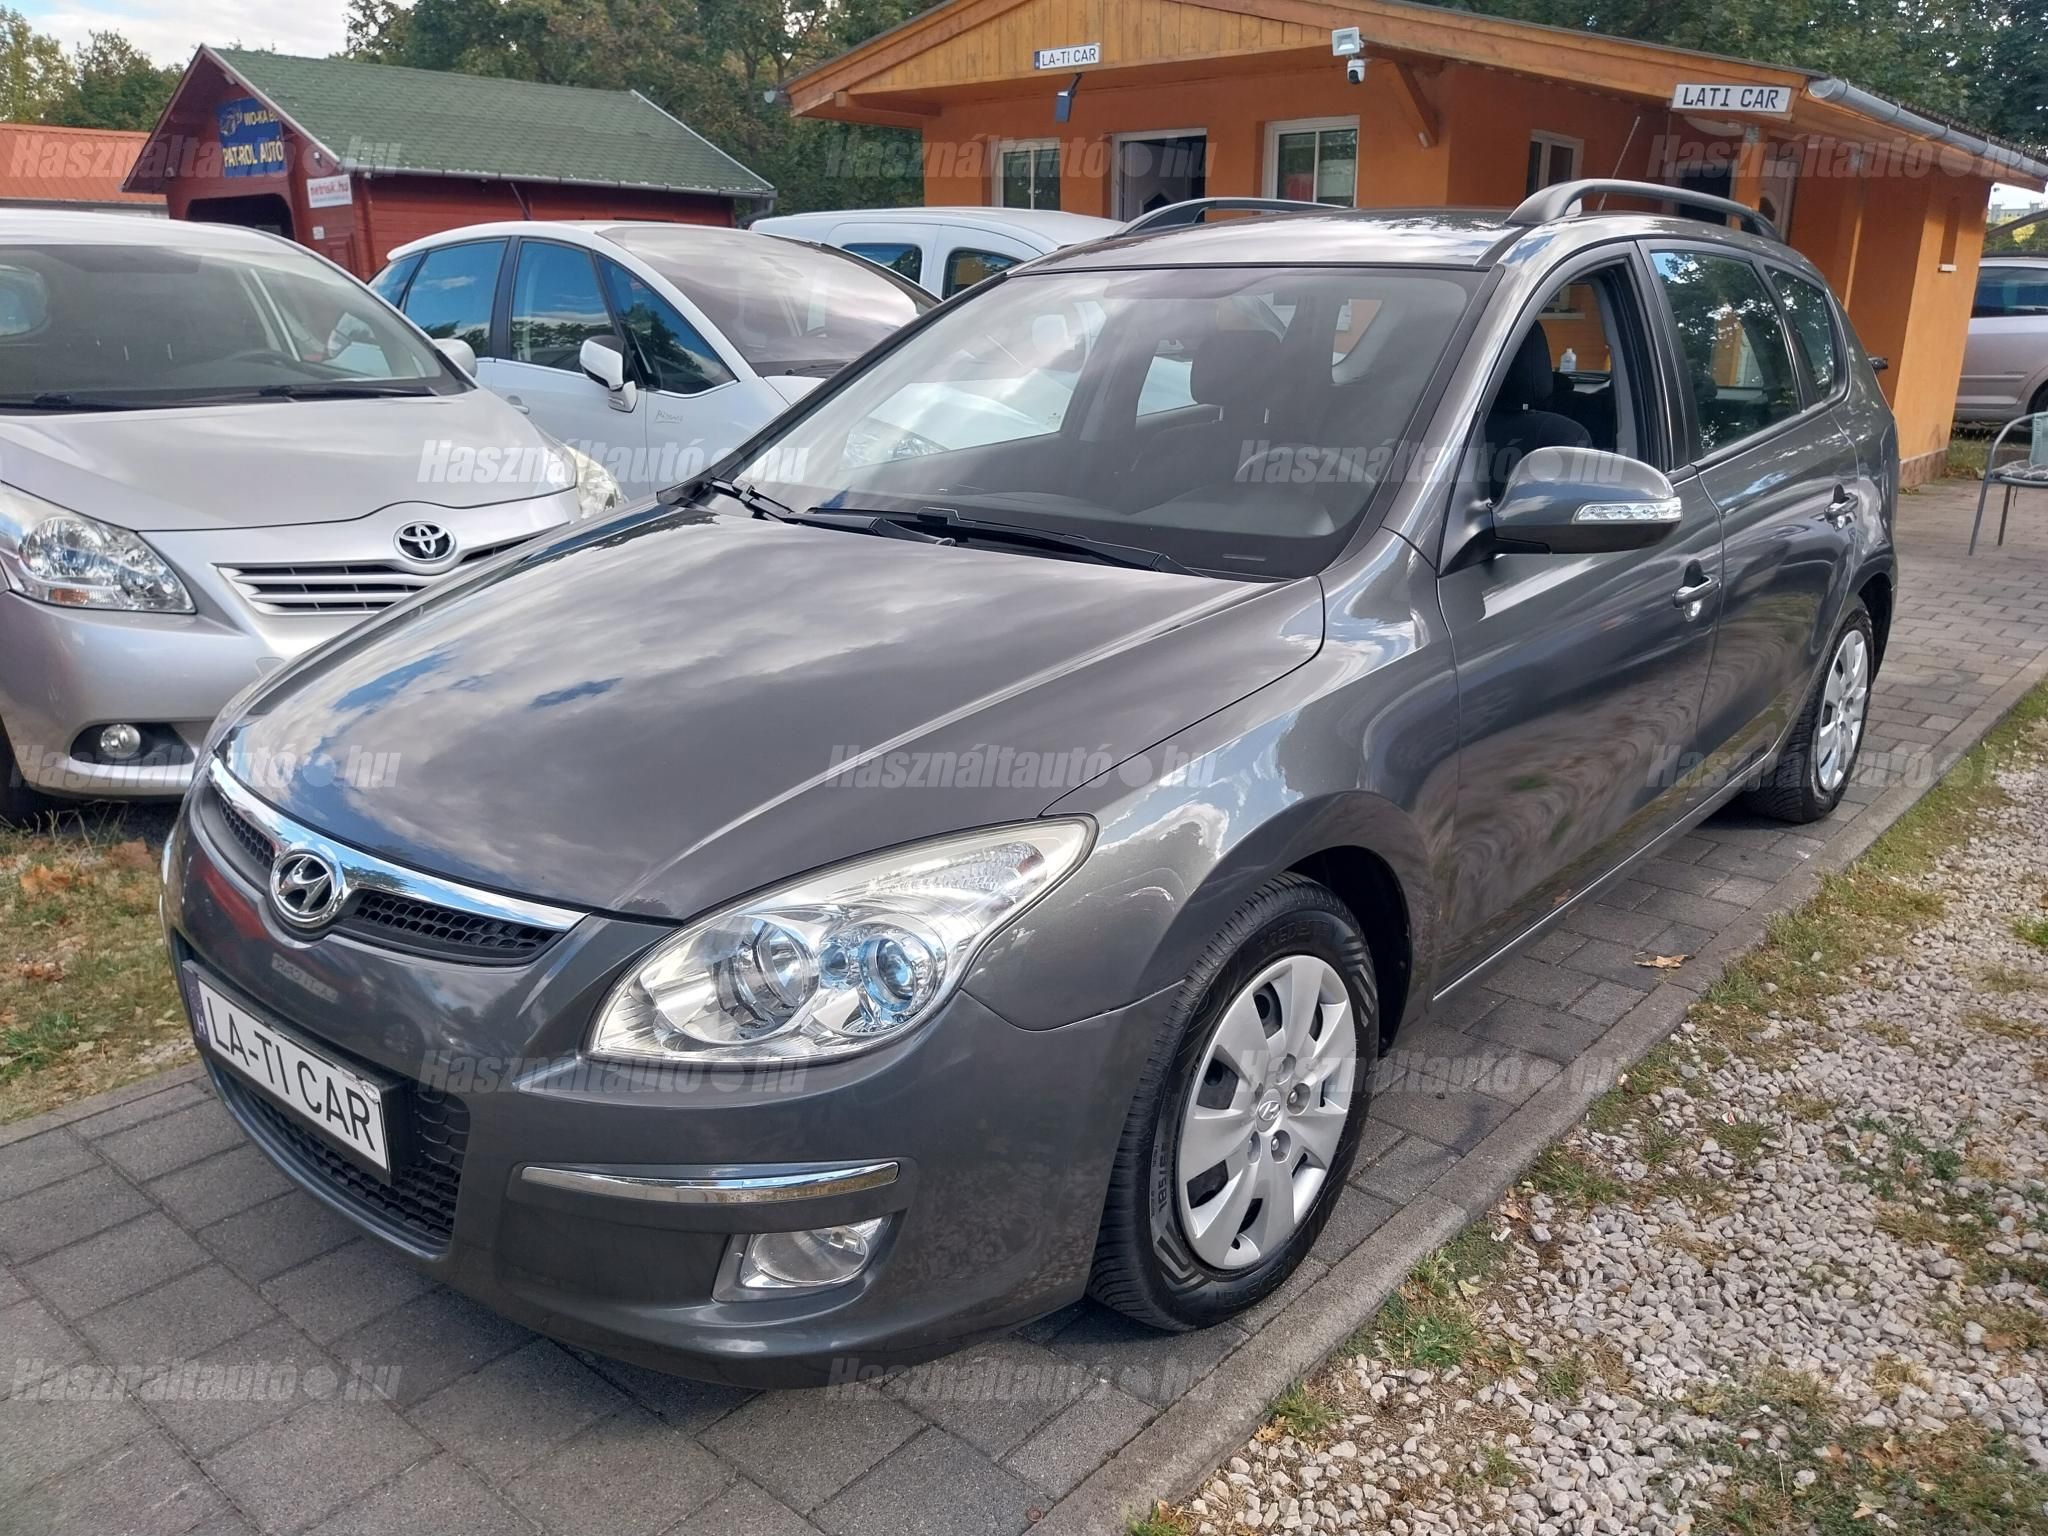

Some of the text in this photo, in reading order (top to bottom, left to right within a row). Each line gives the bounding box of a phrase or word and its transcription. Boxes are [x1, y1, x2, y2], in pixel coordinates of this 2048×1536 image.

[1041, 47, 1097, 67] LA-TI CAR
[1682, 87, 1779, 109] LATI CAR
[261, 136, 284, 164] AUTÓ
[206, 996, 377, 1152] LA-TI CAR
